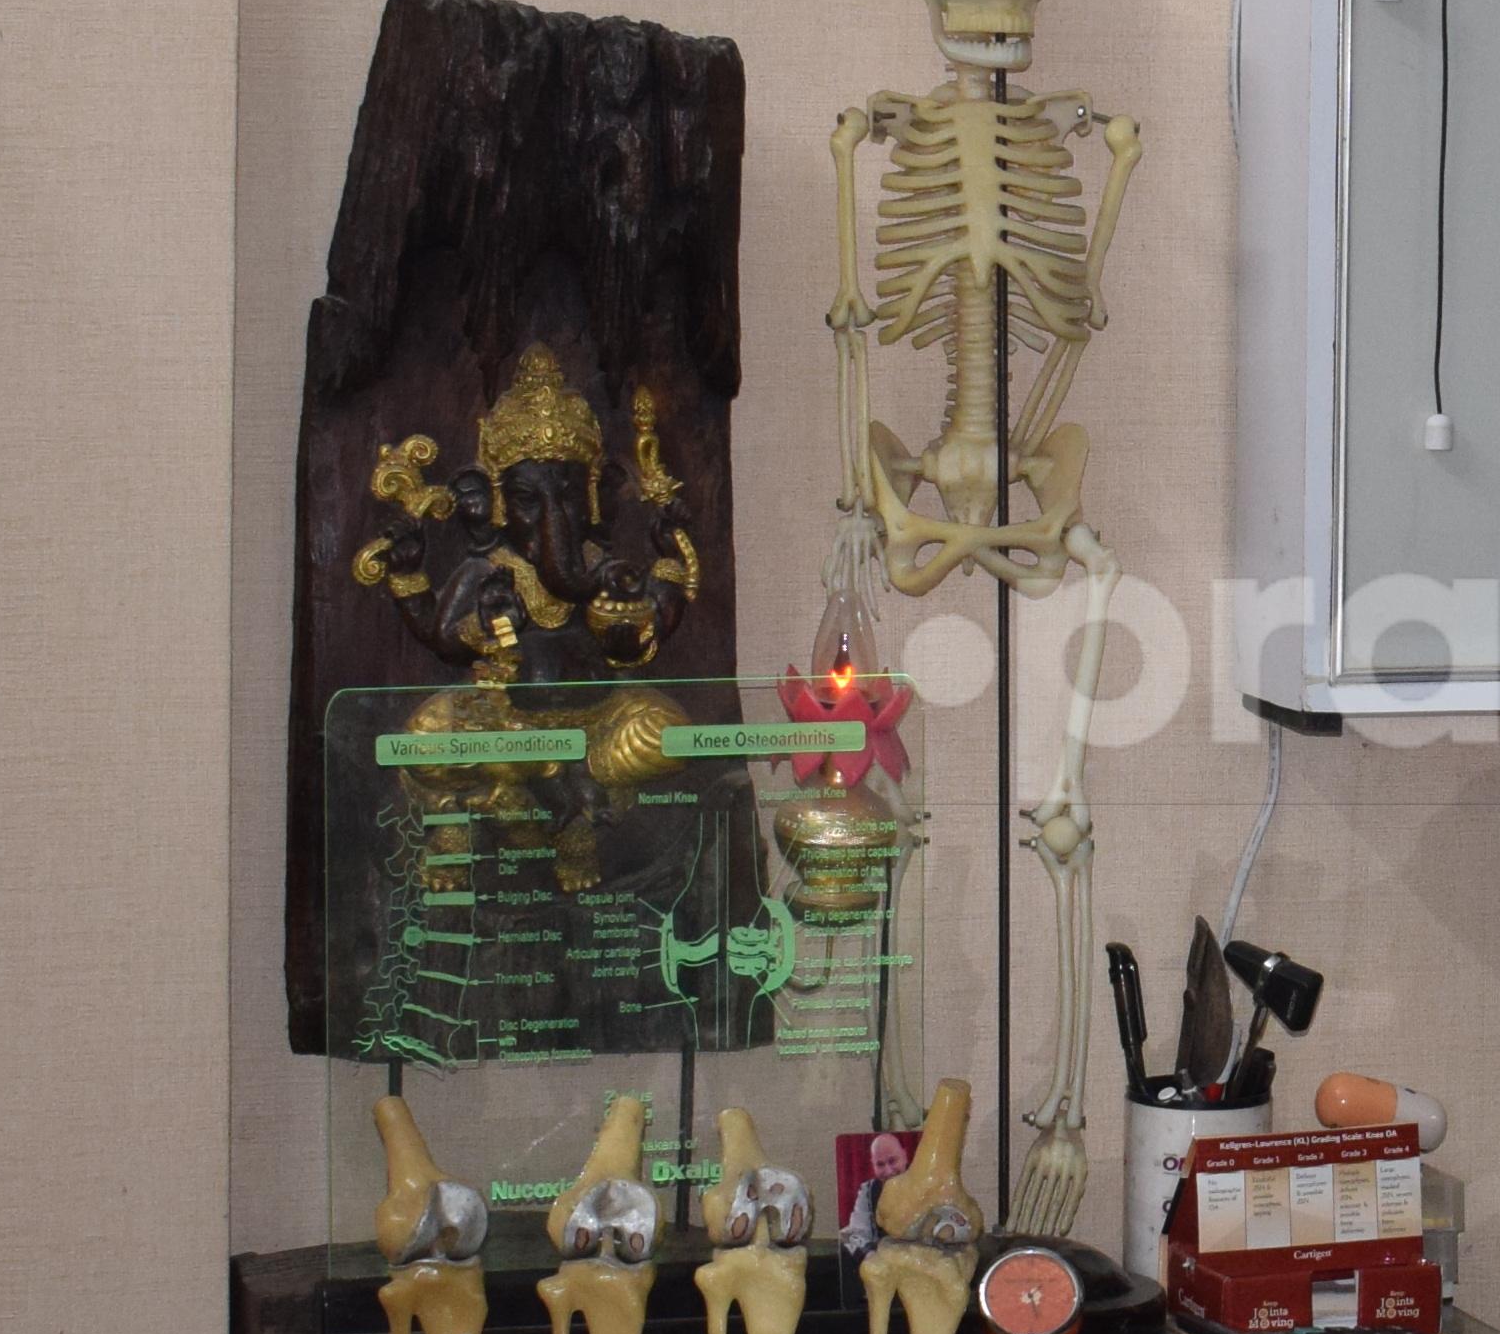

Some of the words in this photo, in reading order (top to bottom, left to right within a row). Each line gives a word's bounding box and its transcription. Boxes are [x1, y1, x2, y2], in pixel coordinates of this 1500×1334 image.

[692, 732, 730, 749] Knee
[734, 729, 836, 748] Osteoarthritis
[390, 739, 445, 757] Various
[449, 736, 491, 758] Spine
[495, 735, 573, 754] Conditions
[638, 791, 672, 804] Normal
[673, 790, 699, 803] Knee
[823, 786, 848, 799] Knee
[532, 807, 553, 821] Disc
[867, 845, 902, 859] capsule
[497, 890, 531, 905] Bulging
[532, 888, 553, 902] Disc
[578, 892, 614, 906] Capsule
[542, 929, 563, 942] Disc
[494, 971, 532, 987] Thinning
[534, 970, 556, 984] Disc
[618, 1000, 643, 1014] Bone
[498, 1018, 519, 1032] Disc
[1311, 1133, 1341, 1146] Grading
[1297, 1152, 1317, 1161] Grade
[1341, 1149, 1361, 1158] Grade
[1383, 1145, 1404, 1155] Grade
[1206, 1159, 1228, 1167] Grade
[1253, 1156, 1274, 1165] Grade
[1293, 1249, 1332, 1261] Cartigen
[1380, 1297, 1415, 1309] Joints
[1253, 1307, 1289, 1319] Joints
[1376, 1306, 1420, 1318] Moving
[1248, 1318, 1294, 1330] Moving
